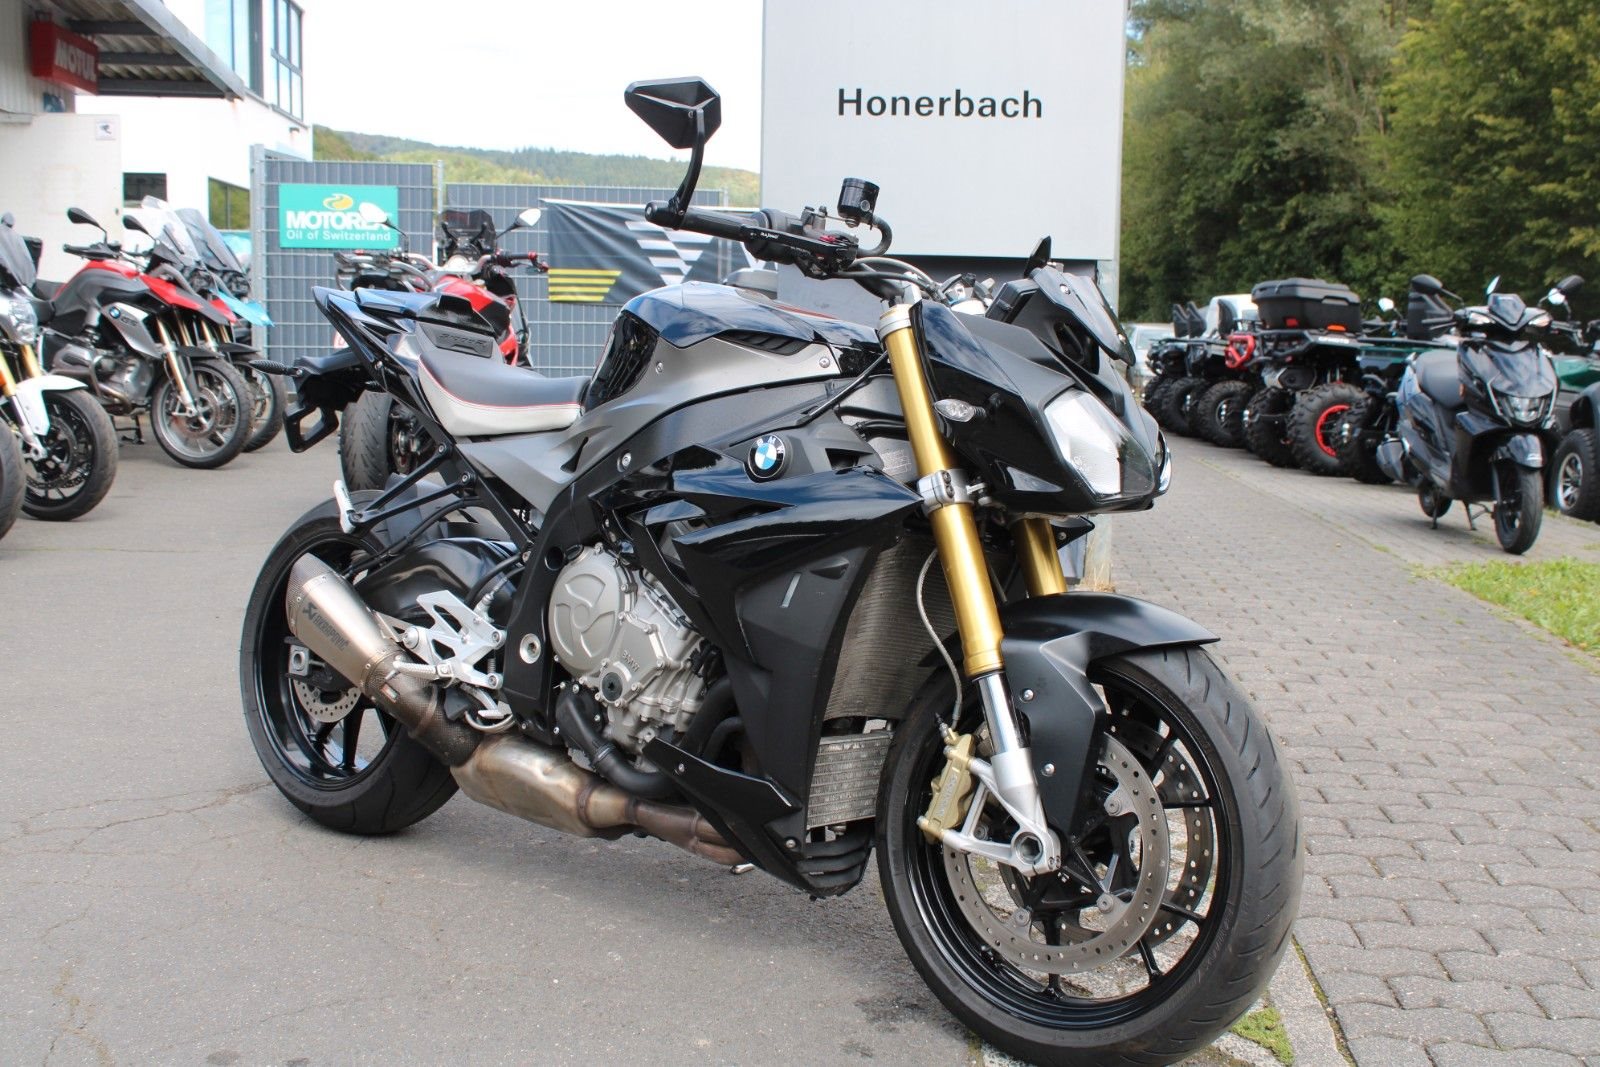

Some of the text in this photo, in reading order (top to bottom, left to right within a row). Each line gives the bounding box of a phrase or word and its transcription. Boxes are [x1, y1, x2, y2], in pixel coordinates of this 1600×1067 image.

[54, 38, 97, 83] MOTUL
[838, 88, 1043, 118] Honerbach
[286, 230, 391, 241] Oil of Switzerland
